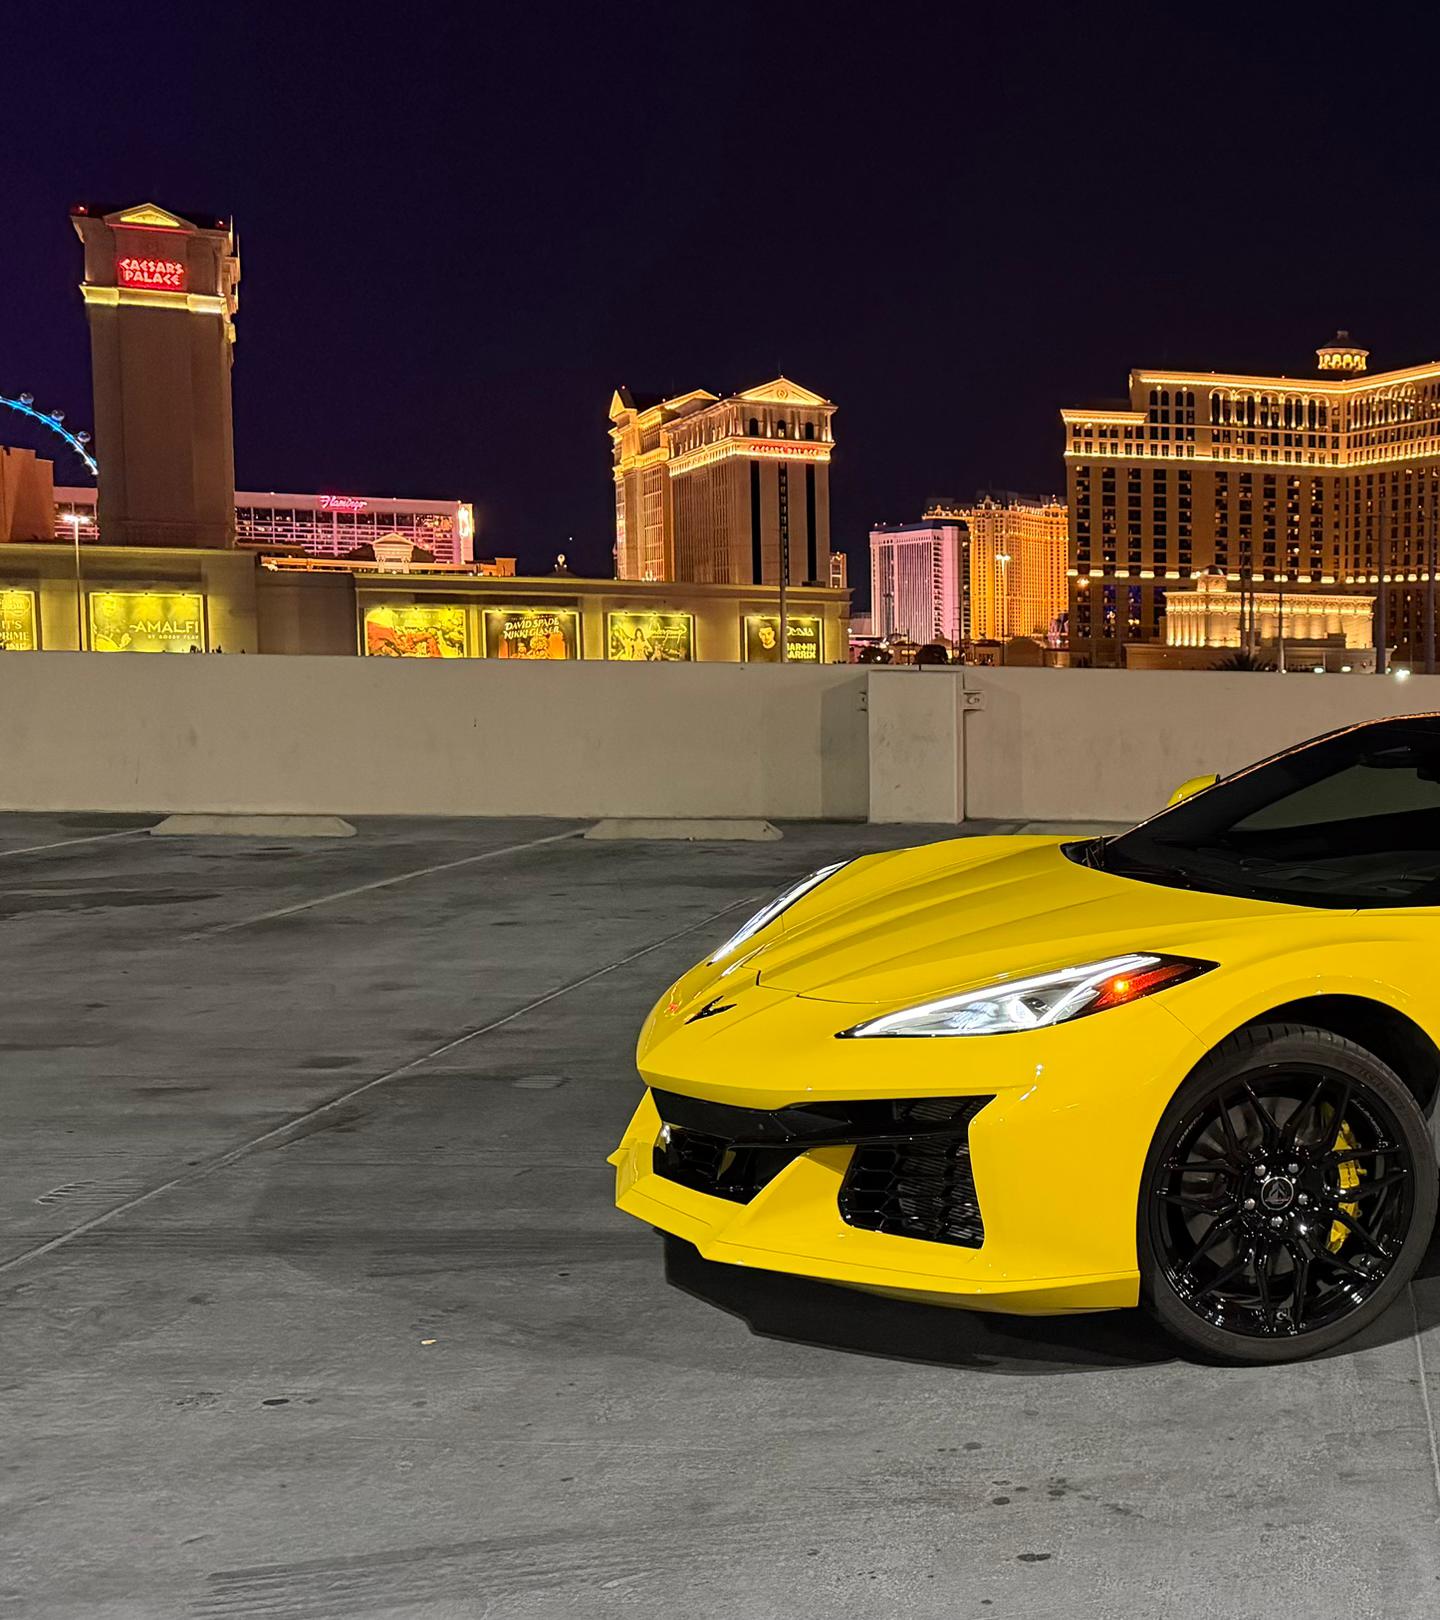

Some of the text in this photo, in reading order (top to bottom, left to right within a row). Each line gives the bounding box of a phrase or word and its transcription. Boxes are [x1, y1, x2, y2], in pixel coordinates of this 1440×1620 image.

[119, 259, 184, 274] CAESARS
[124, 270, 180, 285] PALACE
[320, 496, 367, 511] Flamingo
[130, 620, 199, 633] AMALFI
[504, 620, 532, 631] DAVID
[533, 617, 560, 628] SPADE
[503, 629, 528, 639] NIKKI
[786, 650, 816, 659] ARRIX
